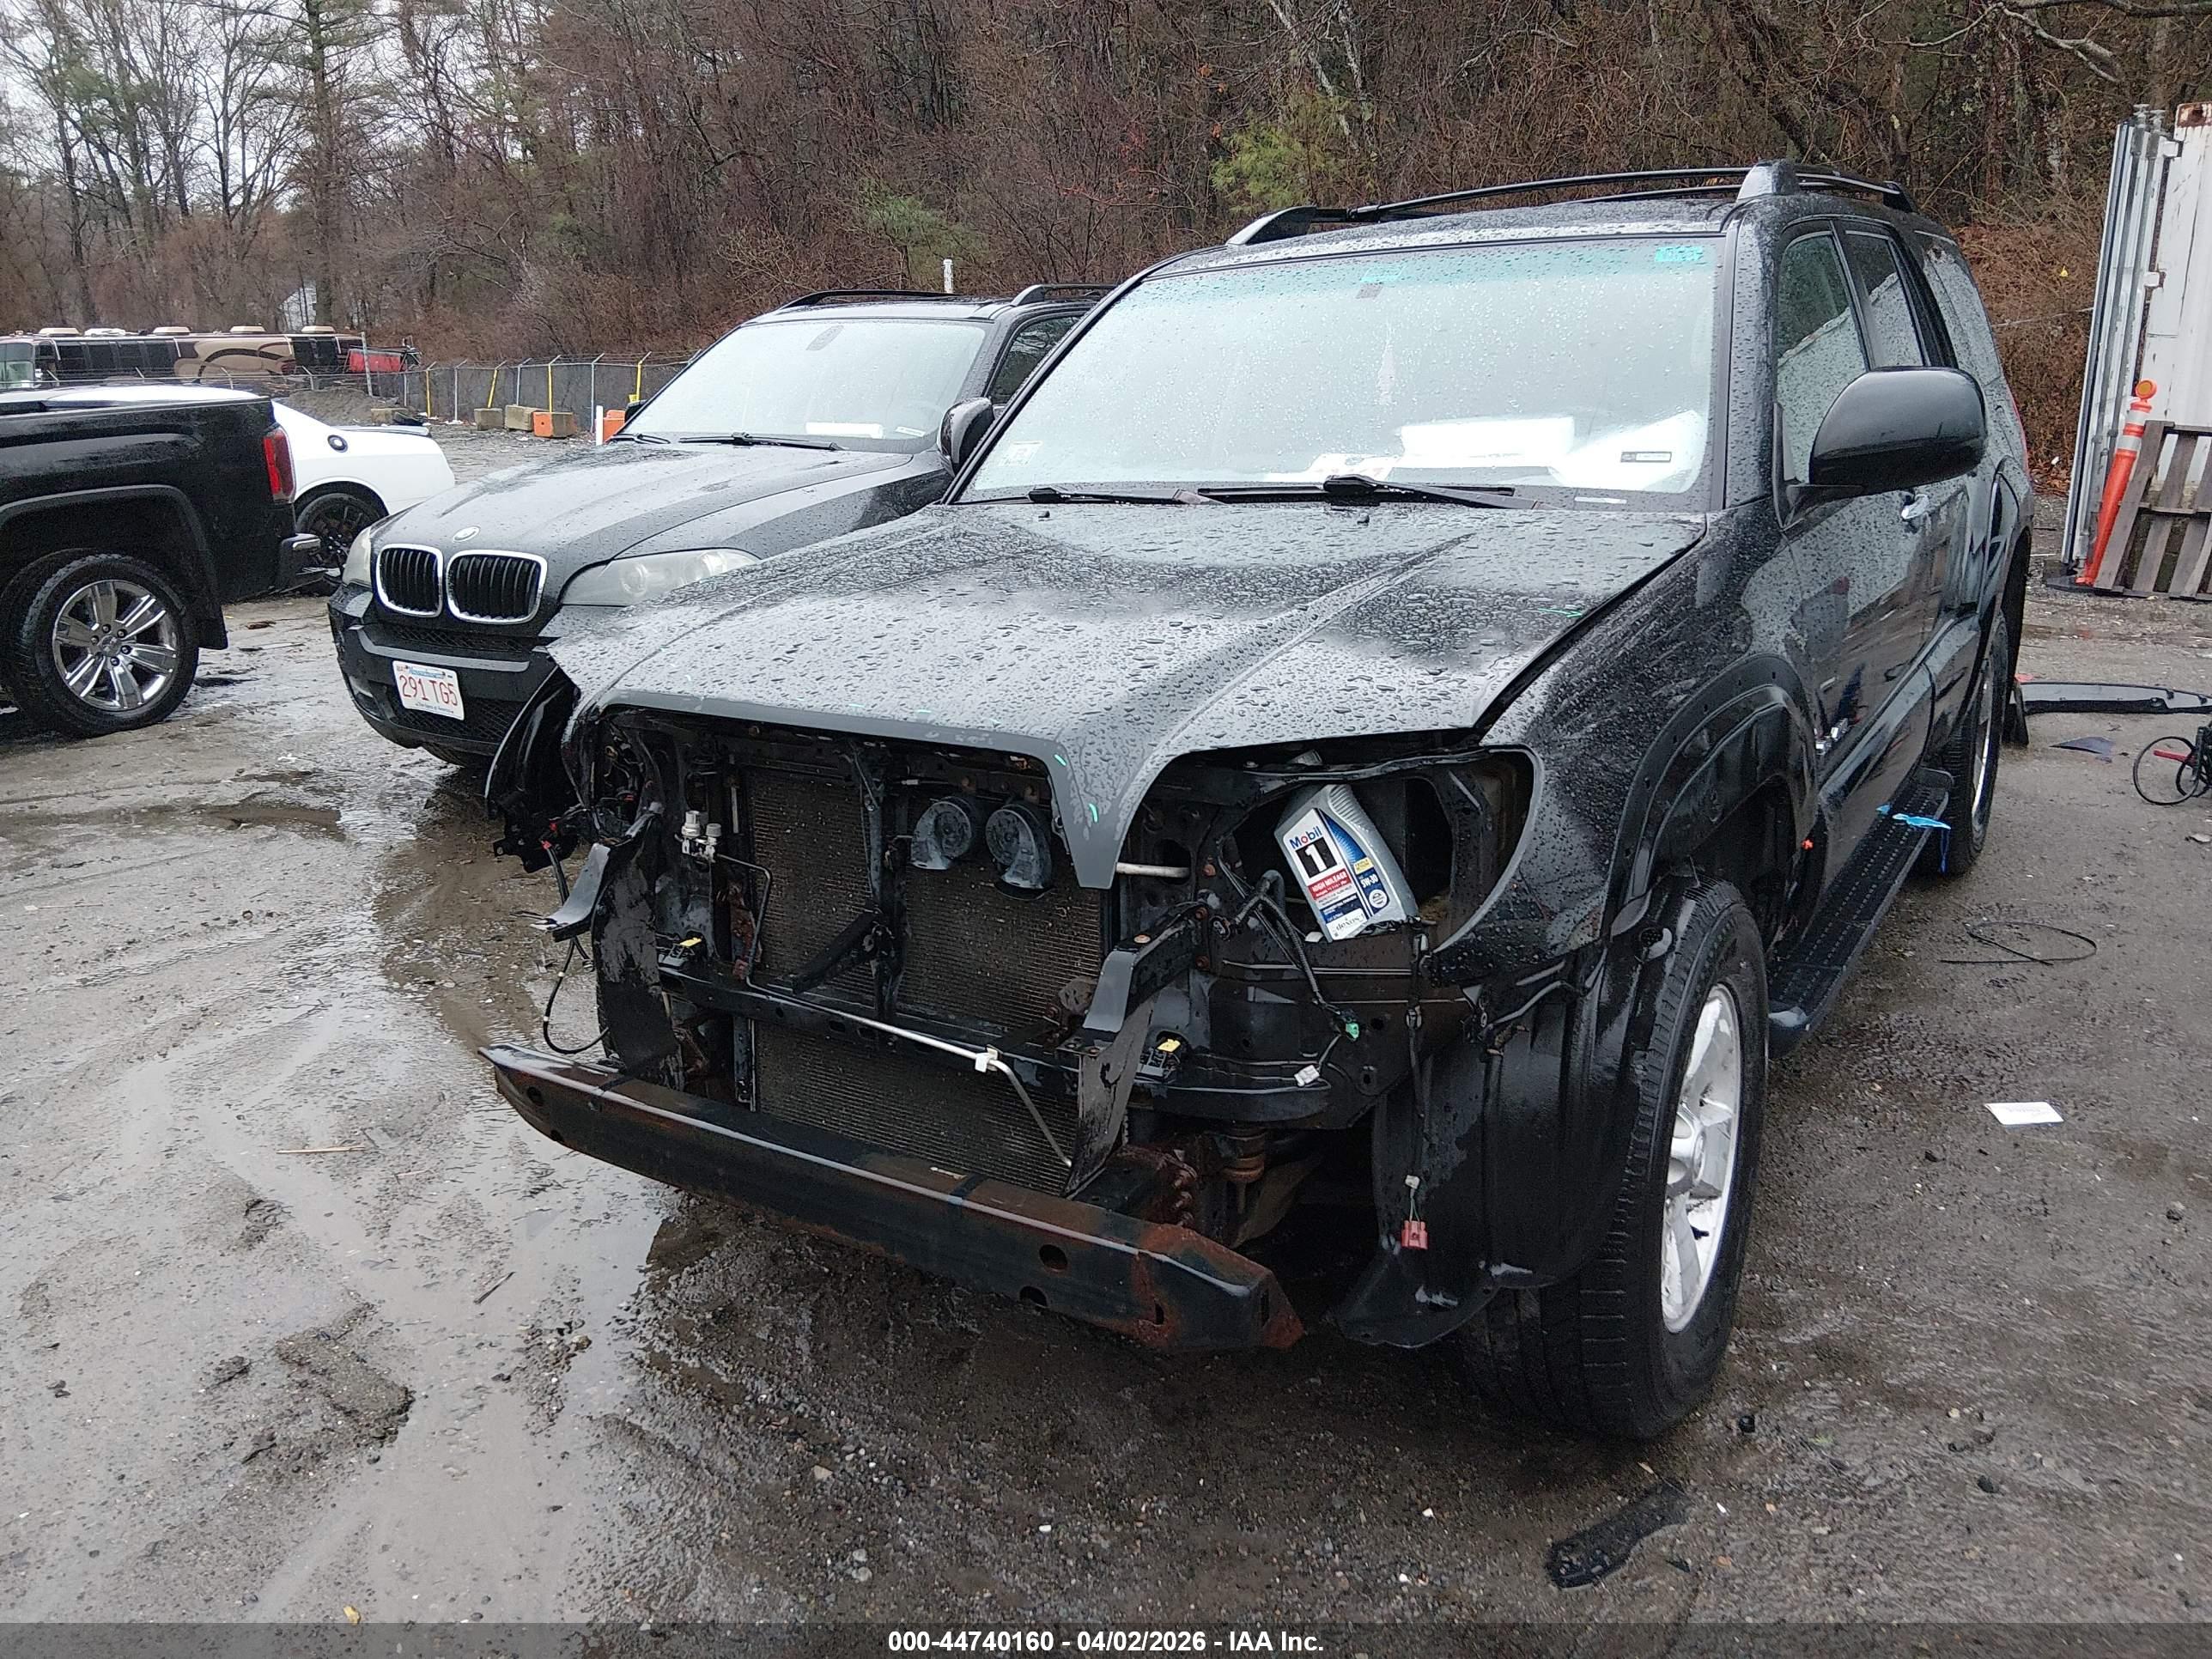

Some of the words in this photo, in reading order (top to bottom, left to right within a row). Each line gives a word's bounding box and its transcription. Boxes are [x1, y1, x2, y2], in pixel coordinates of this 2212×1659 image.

[399, 675, 429, 701] 291
[429, 680, 458, 706] TG5
[1290, 826, 1322, 849] Mobil
[1305, 844, 1328, 872] 1
[1325, 871, 1347, 886] MILEAGE
